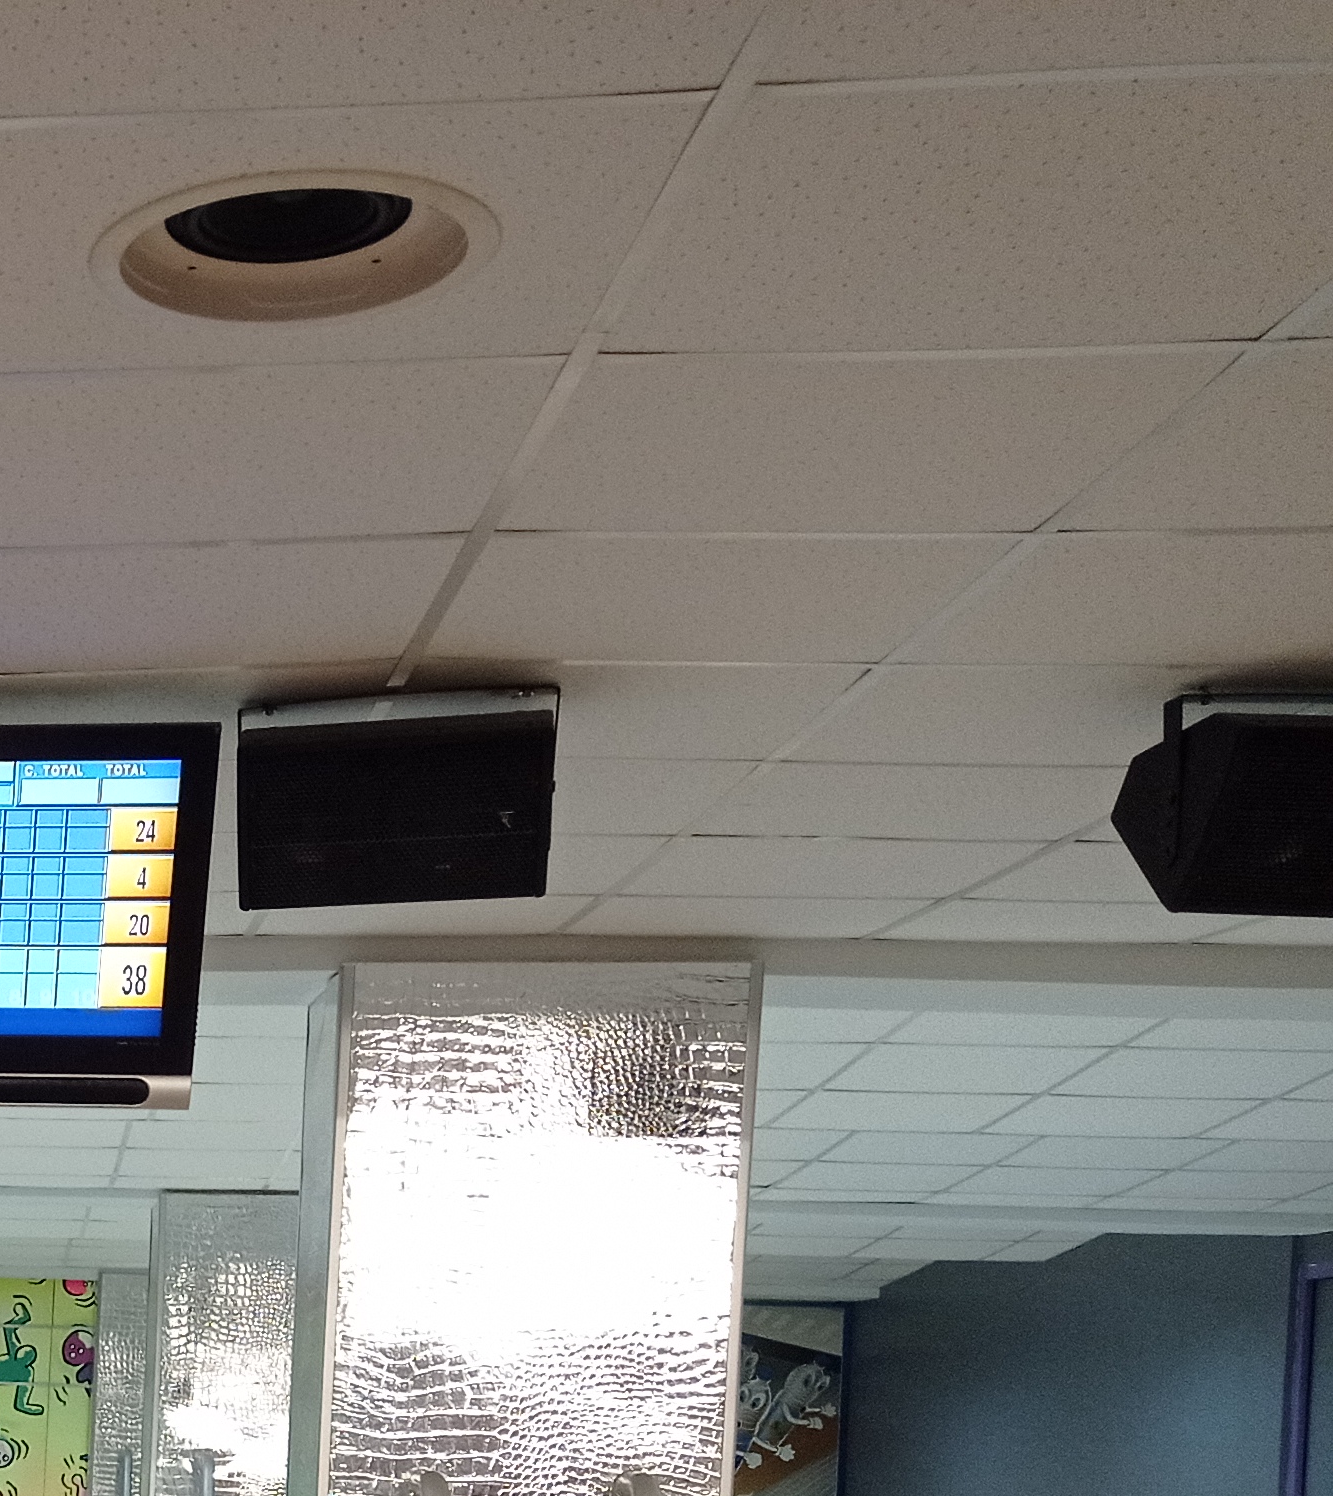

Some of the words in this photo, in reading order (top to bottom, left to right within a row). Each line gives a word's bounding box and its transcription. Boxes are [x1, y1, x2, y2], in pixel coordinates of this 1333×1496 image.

[42, 764, 83, 777] TOTAL
[105, 763, 147, 776] TOTAL
[135, 820, 156, 843] 24
[136, 867, 147, 890] 4
[128, 914, 150, 936] 20
[121, 965, 148, 996] 38
